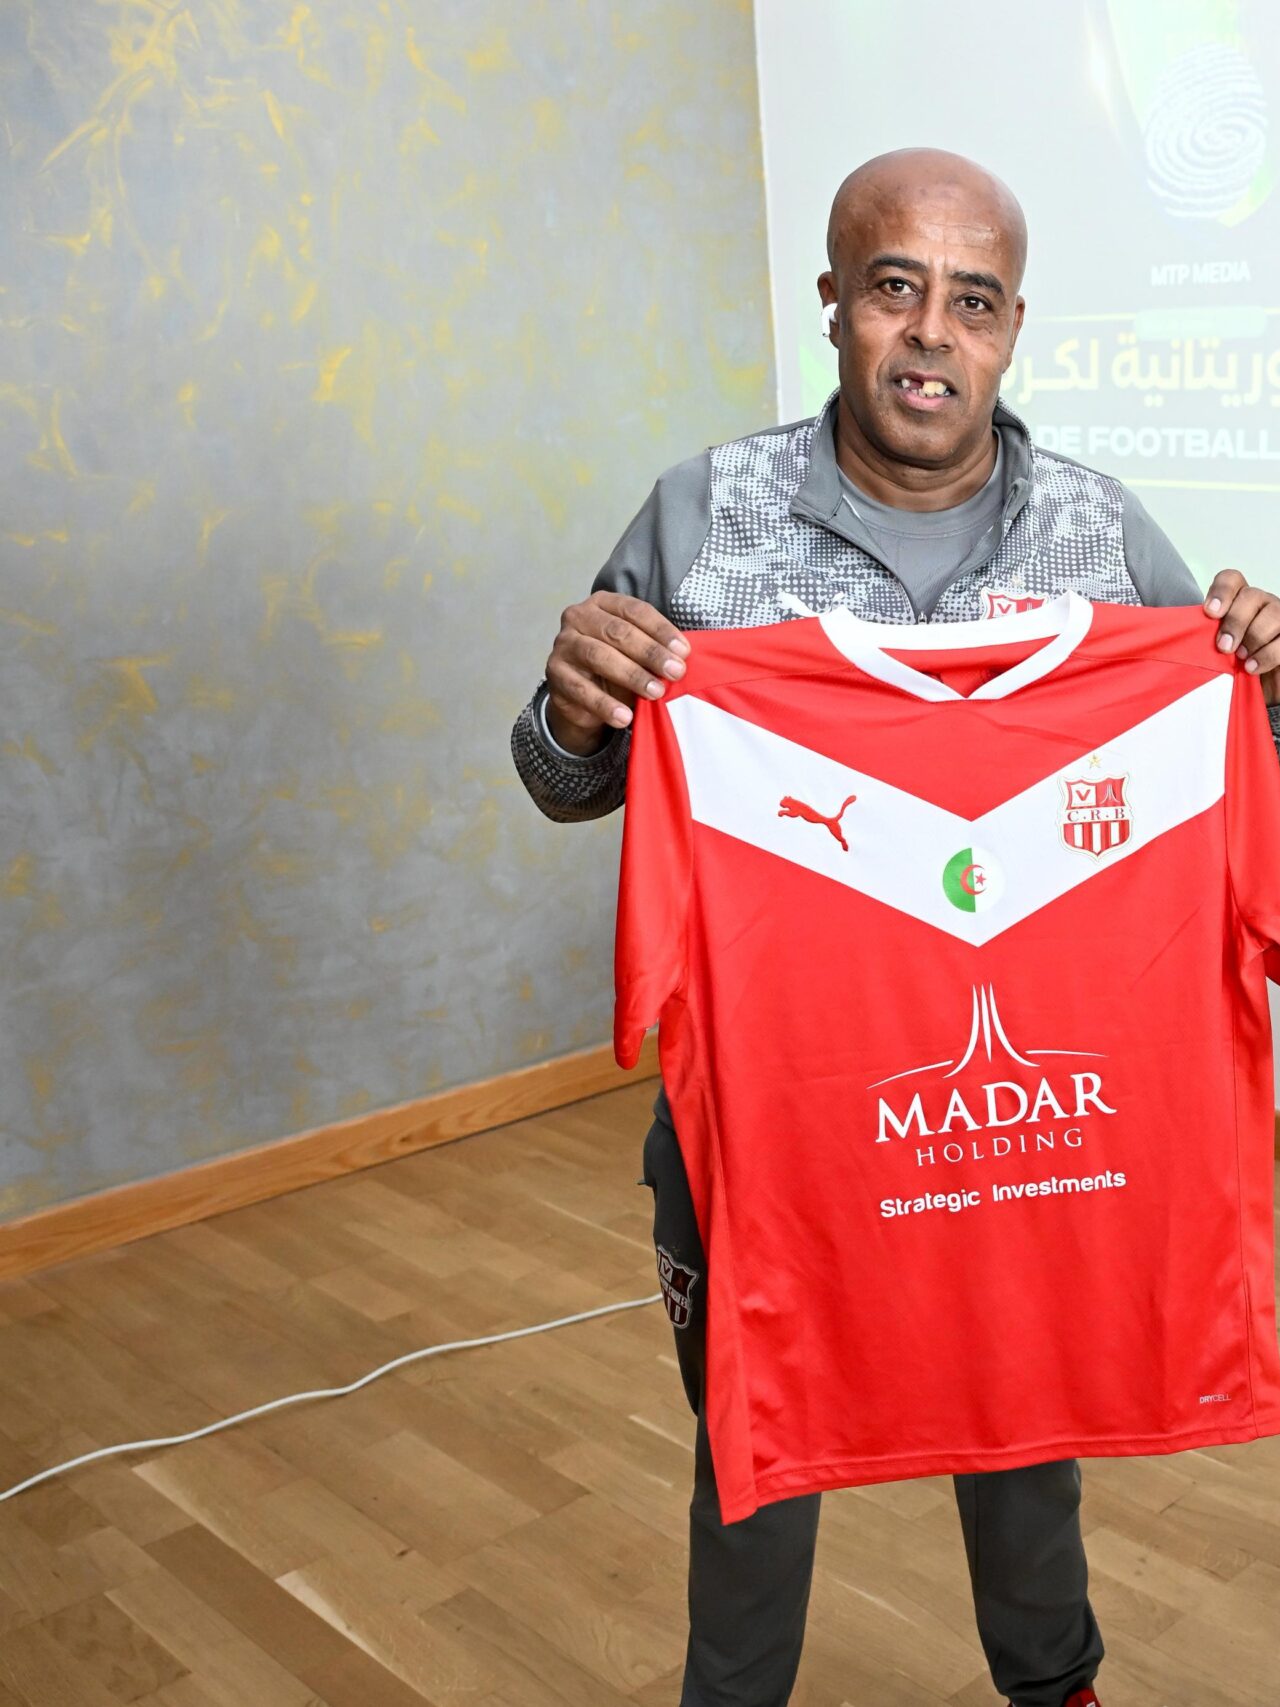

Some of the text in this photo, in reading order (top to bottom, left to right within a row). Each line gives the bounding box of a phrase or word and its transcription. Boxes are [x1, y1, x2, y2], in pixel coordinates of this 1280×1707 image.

[1150, 260, 1251, 287] MTP MEDIA
[1034, 424, 1082, 456] DE
[875, 1072, 1117, 1143] MADAR
[915, 1128, 1083, 1166] HOLDING
[879, 1170, 1126, 1218] Strategic Investments
